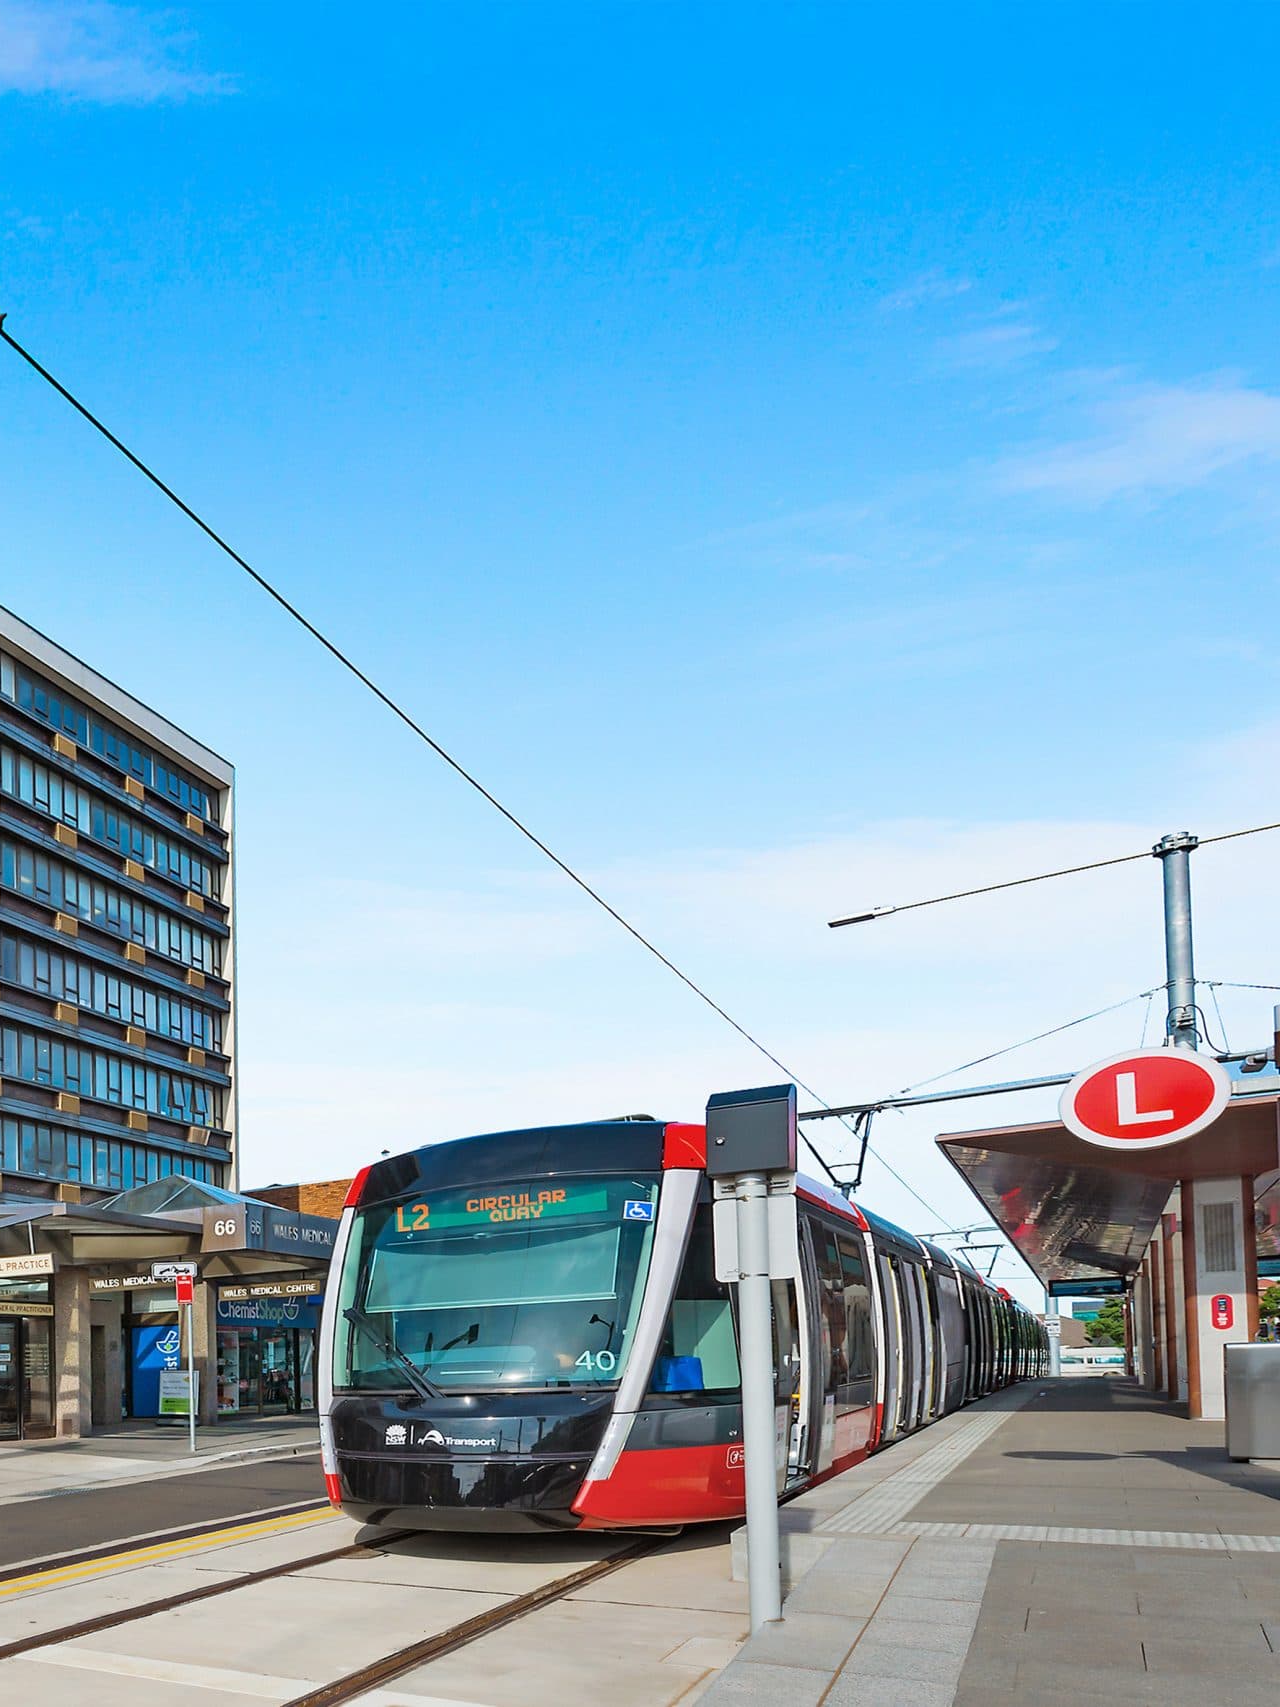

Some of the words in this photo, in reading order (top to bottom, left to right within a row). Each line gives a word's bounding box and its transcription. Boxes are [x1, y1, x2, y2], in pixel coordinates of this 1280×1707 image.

[1115, 1072, 1175, 1127] L
[396, 1203, 430, 1233] L2
[466, 1188, 567, 1213] CIRCULAR
[489, 1204, 544, 1223] QUAY
[214, 1219, 236, 1236] 66
[273, 1223, 299, 1241] WALES
[301, 1228, 333, 1246] MEDICAL
[6, 1259, 50, 1271] PRACTICE
[93, 1278, 120, 1290] WALES
[122, 1275, 158, 1287] MEDICAL
[223, 1287, 248, 1298] WALES
[250, 1285, 283, 1297] MEDICAL
[286, 1283, 317, 1294] CENTRE
[16, 1305, 52, 1314] PRACTITIONER
[574, 1350, 616, 1372] 40
[385, 1435, 407, 1444] NSW
[444, 1437, 497, 1448] Transport
